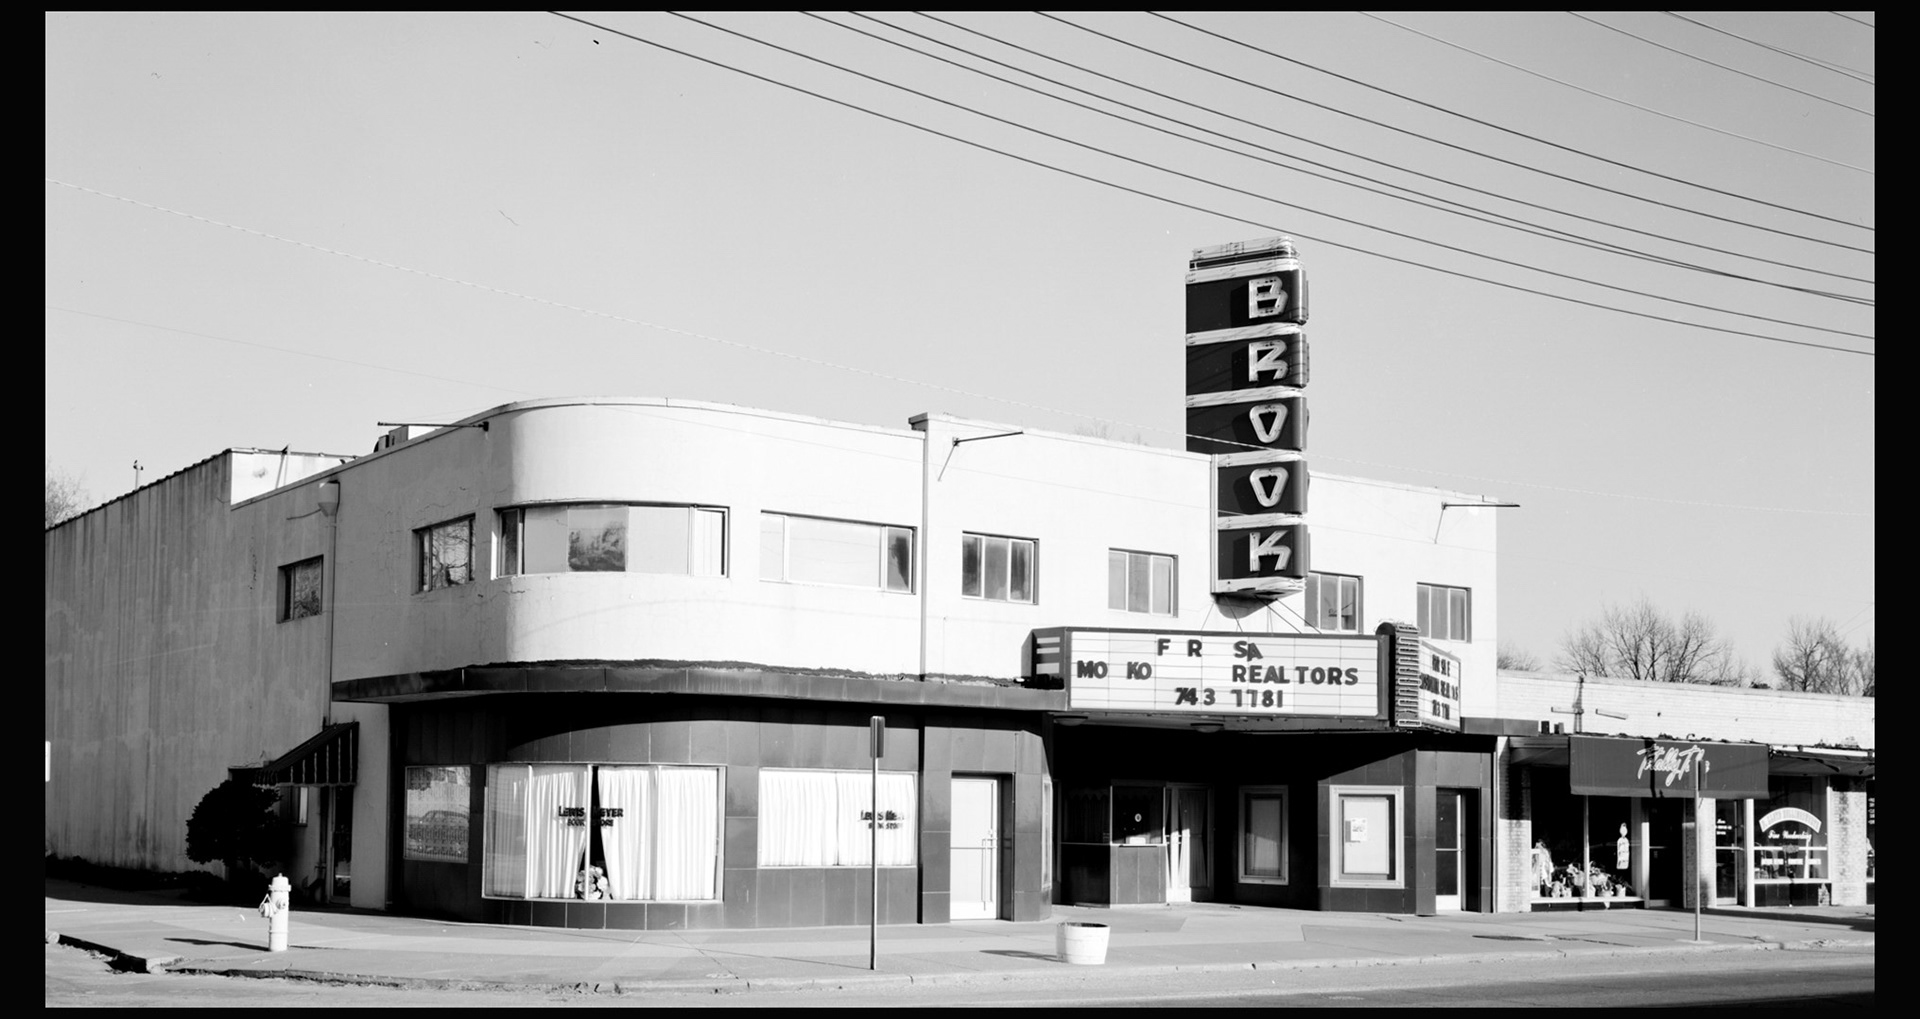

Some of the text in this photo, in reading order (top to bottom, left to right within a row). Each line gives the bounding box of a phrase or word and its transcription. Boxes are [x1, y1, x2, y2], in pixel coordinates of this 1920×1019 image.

[1248, 276, 1291, 572] BROOK
[1157, 638, 1263, 662] F R SA
[1077, 660, 1359, 686] MO KO REALTORS
[1175, 687, 1283, 708] 743 7781
